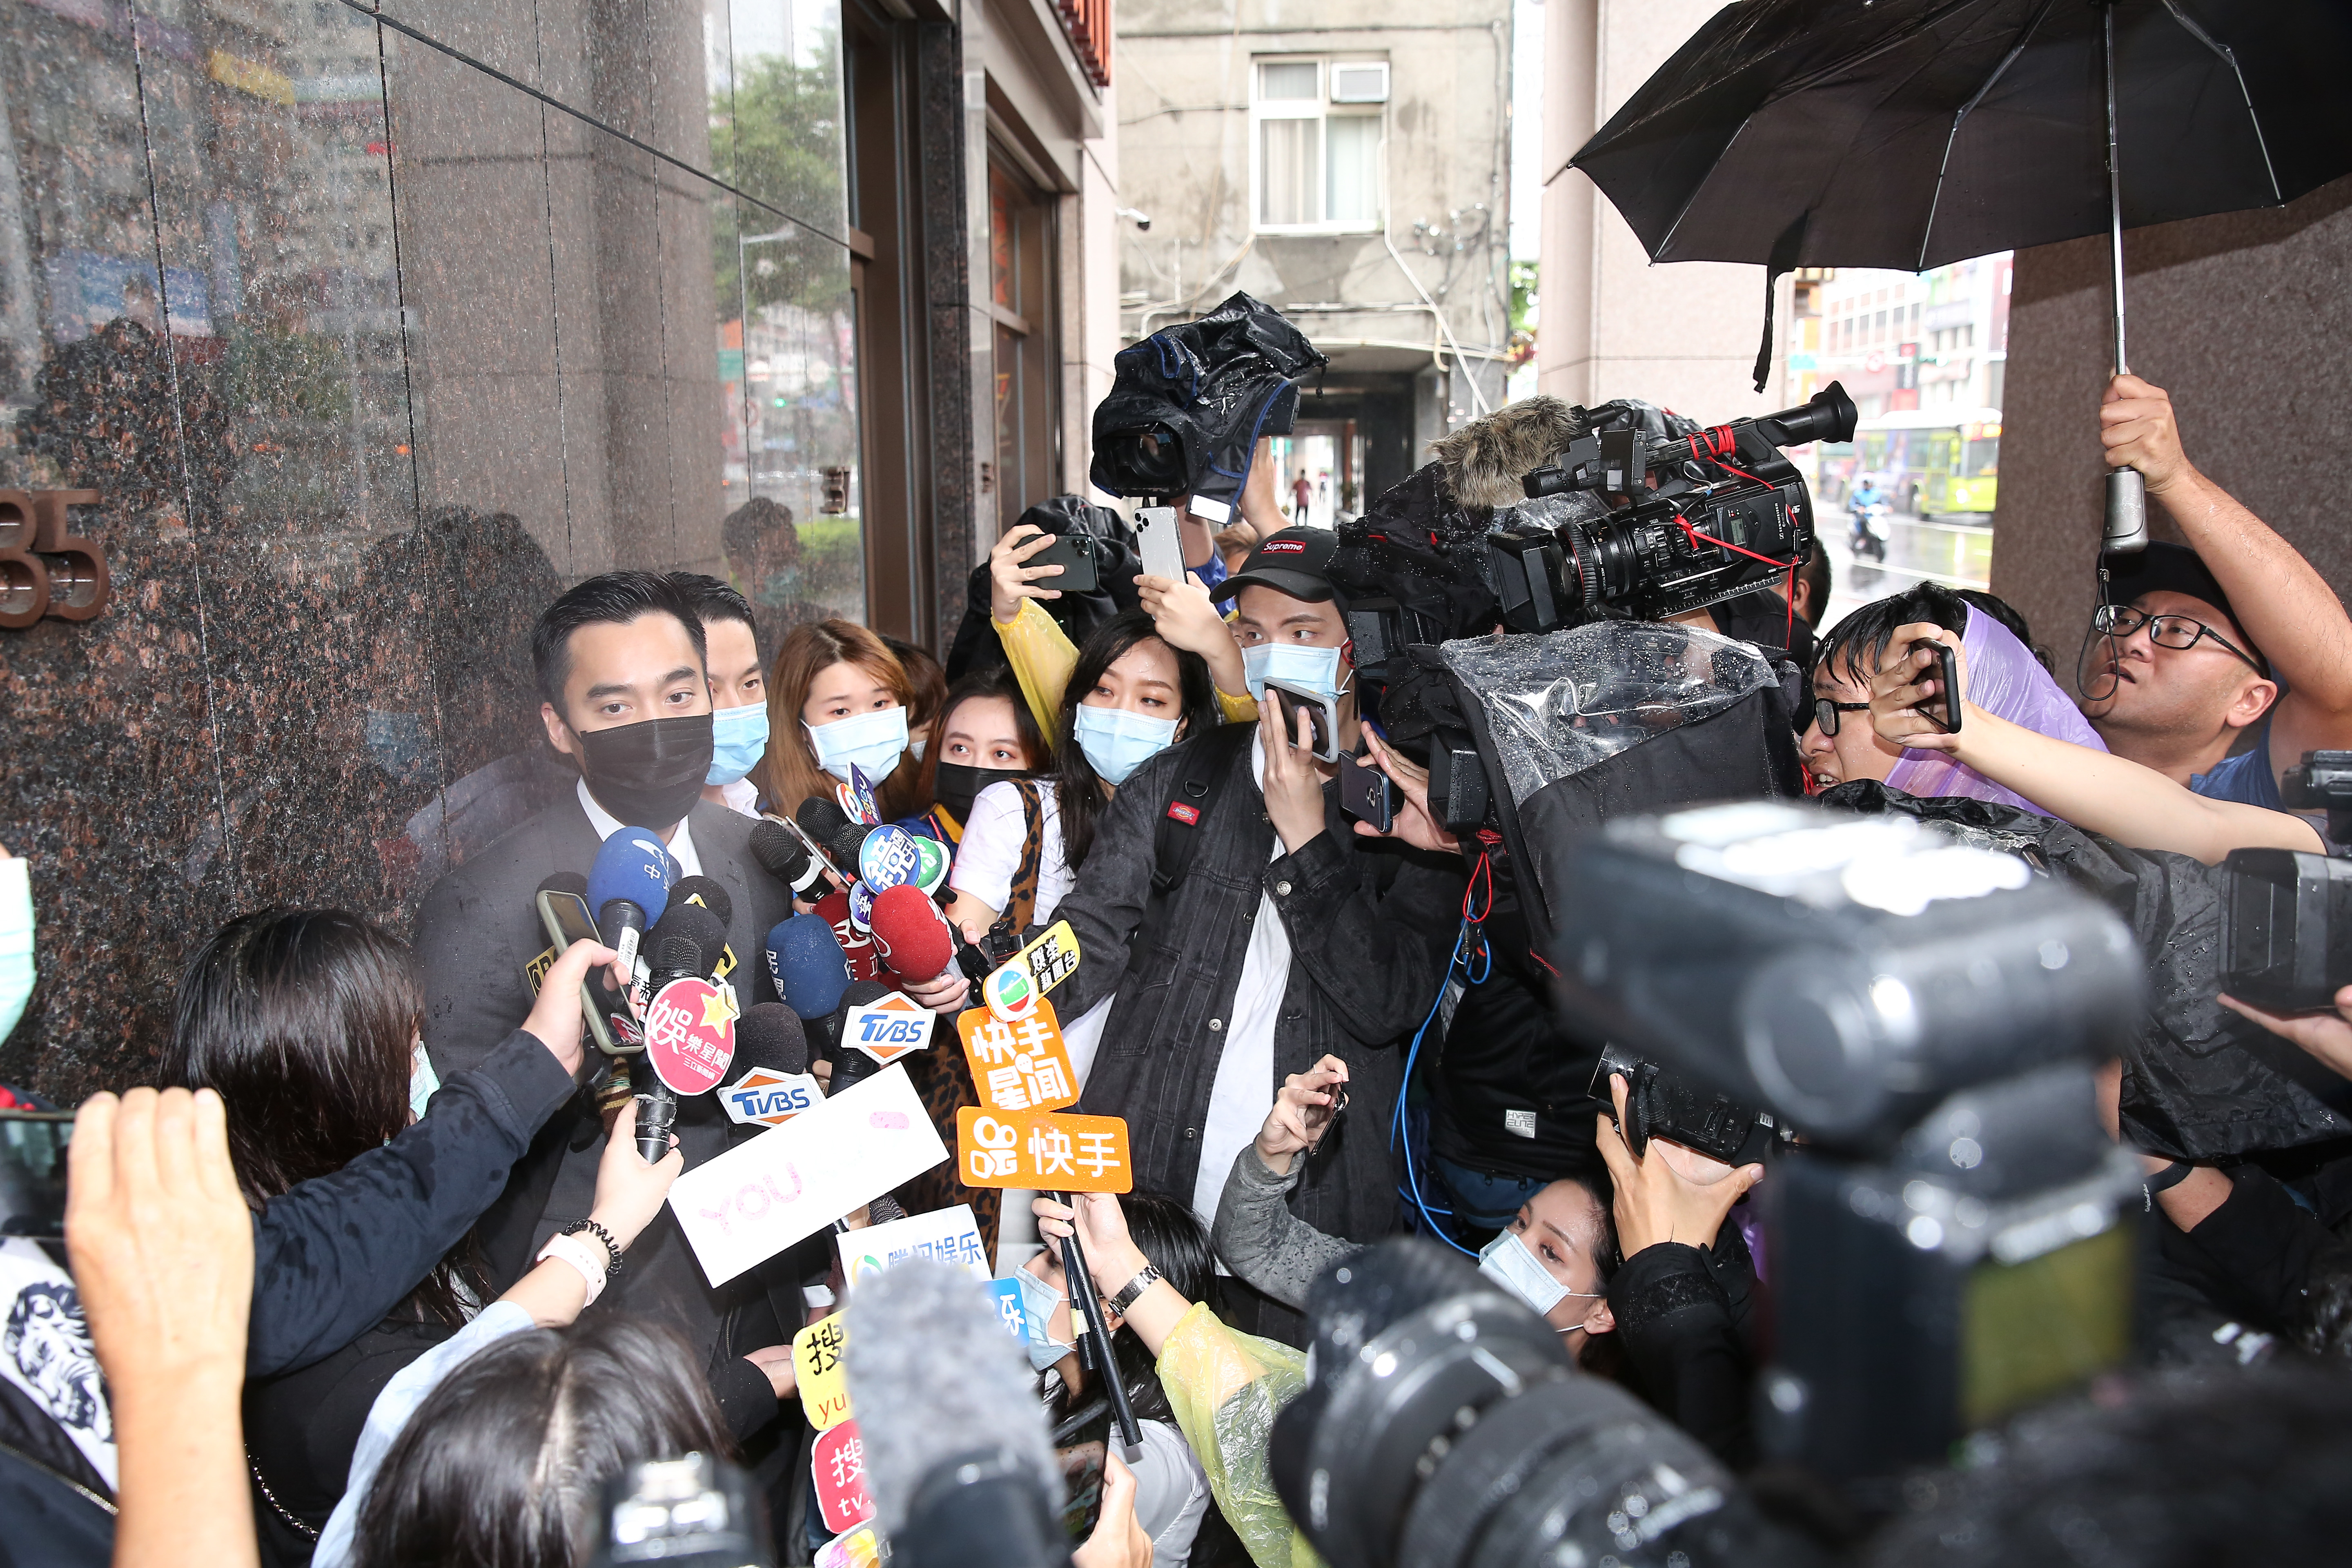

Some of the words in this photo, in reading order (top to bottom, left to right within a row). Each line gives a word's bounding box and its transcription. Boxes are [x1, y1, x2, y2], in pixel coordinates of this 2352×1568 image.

[1775, 503, 1783, 532] SENNHEISER
[1263, 542, 1303, 552] Supreme
[859, 1014, 925, 1042] TVBS
[971, 1006, 1054, 1064] 快手
[987, 1056, 1071, 1110] 星闻
[732, 1088, 810, 1116] TVBS
[1507, 1111, 1534, 1120] HYPER
[1507, 1118, 1534, 1128] ELITE
[1027, 1127, 1120, 1178] 快手
